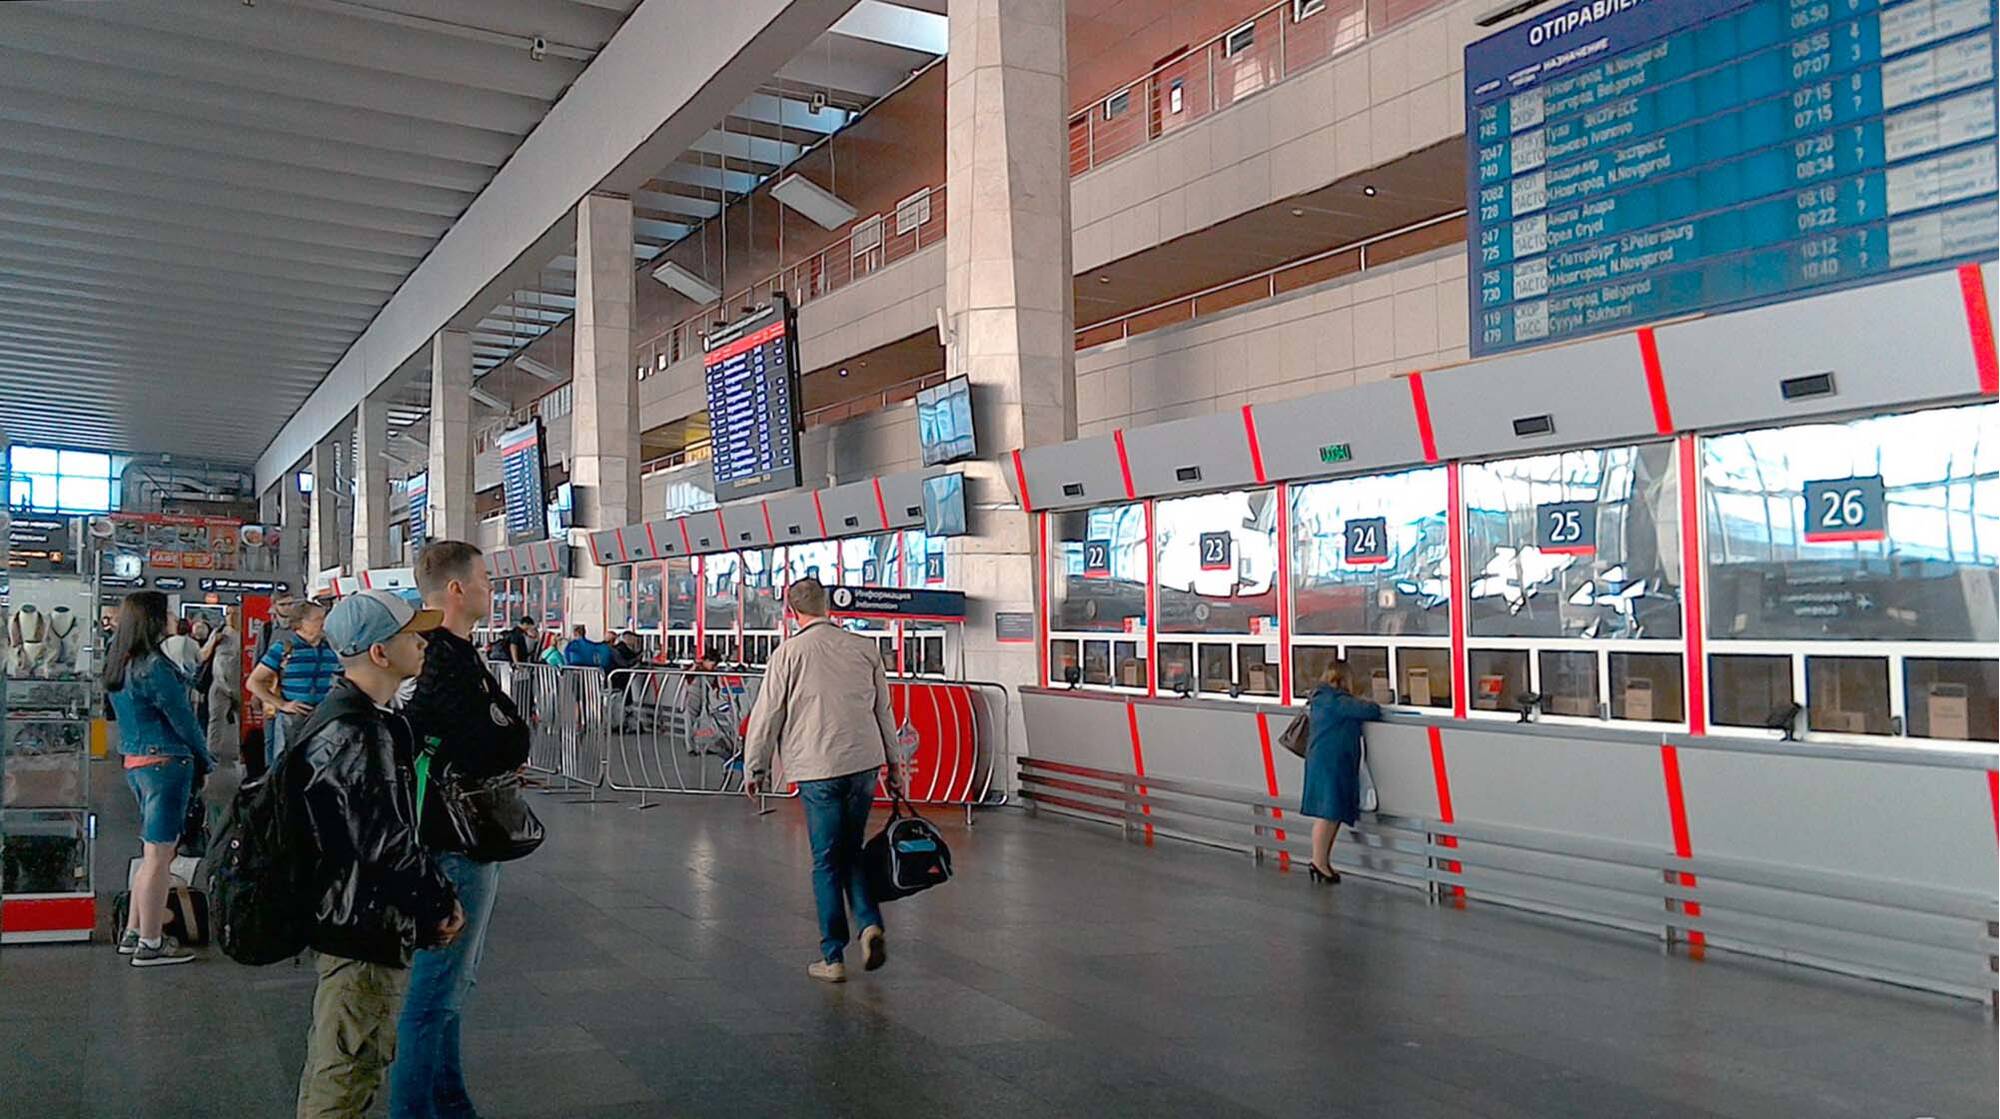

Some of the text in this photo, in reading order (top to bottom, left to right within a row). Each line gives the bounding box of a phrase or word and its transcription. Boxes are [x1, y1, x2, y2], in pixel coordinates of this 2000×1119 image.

[1529, 0, 1643, 45] ОТПРАВЛЕ
[1793, 53, 1831, 79] 07:07
[1794, 82, 1832, 108] 07:15
[1794, 104, 1833, 128] 07:15
[1480, 122, 1497, 139] 745
[1480, 144, 1504, 163] 7047
[1608, 153, 1671, 184] N.Novgorod
[1481, 228, 1499, 245] 247
[1620, 223, 1694, 253] S.Petersburg
[1802, 237, 1838, 258] 10:12
[1482, 245, 1500, 262] 725
[1610, 245, 1674, 273] N.Novgorod
[1482, 287, 1501, 303] 730
[1602, 280, 1652, 302] Belgorod
[1484, 312, 1501, 328] 119
[1821, 489, 1864, 527] 26
[1549, 510, 1582, 543] 25
[1205, 539, 1224, 562] 23
[1353, 526, 1377, 553] 24
[1089, 547, 1105, 568] 22
[854, 589, 912, 600] Информация
[854, 601, 899, 610] Information
